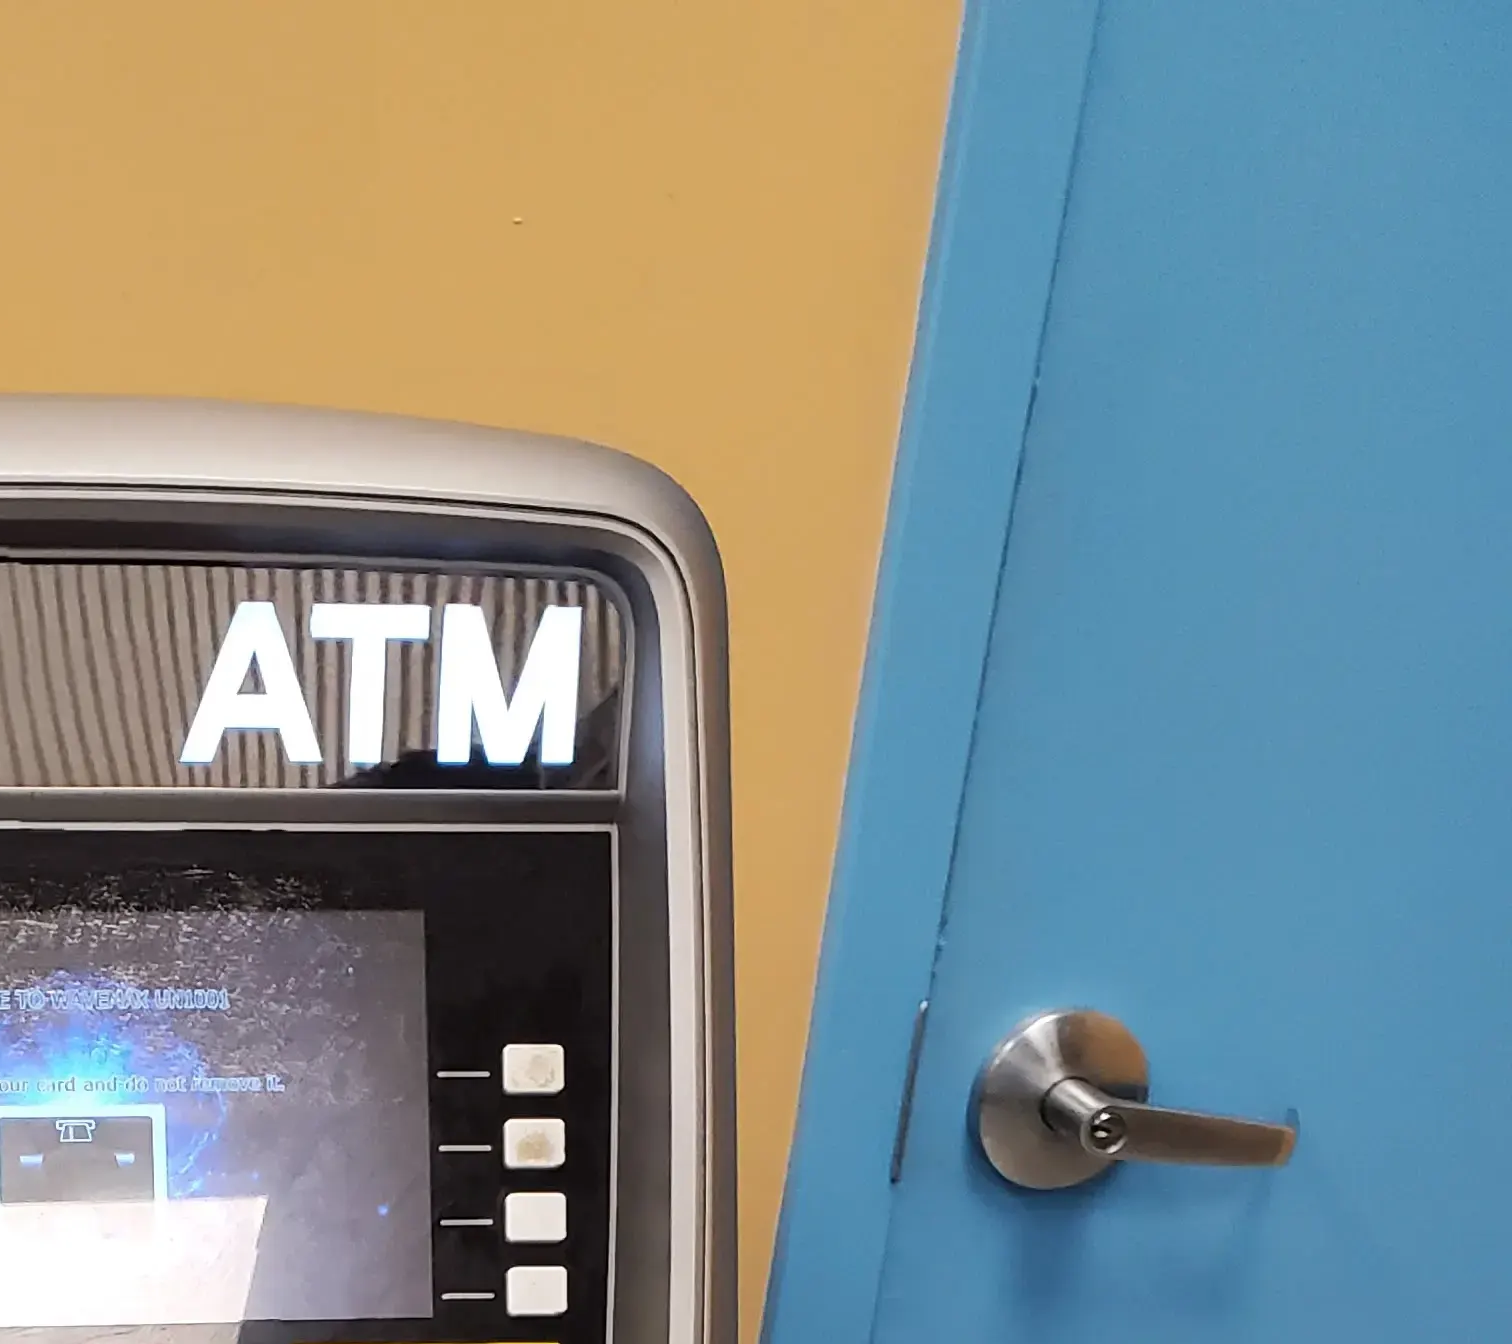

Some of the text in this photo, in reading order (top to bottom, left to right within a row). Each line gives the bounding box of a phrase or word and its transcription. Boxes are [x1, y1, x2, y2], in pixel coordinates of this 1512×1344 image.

[179, 601, 582, 766] ATM
[15, 989, 44, 1010] TO
[37, 1077, 75, 1092] card
[84, 1076, 117, 1092] and
[124, 1076, 149, 1092] do
[155, 1077, 186, 1092] not
[191, 1077, 262, 1092] remove
